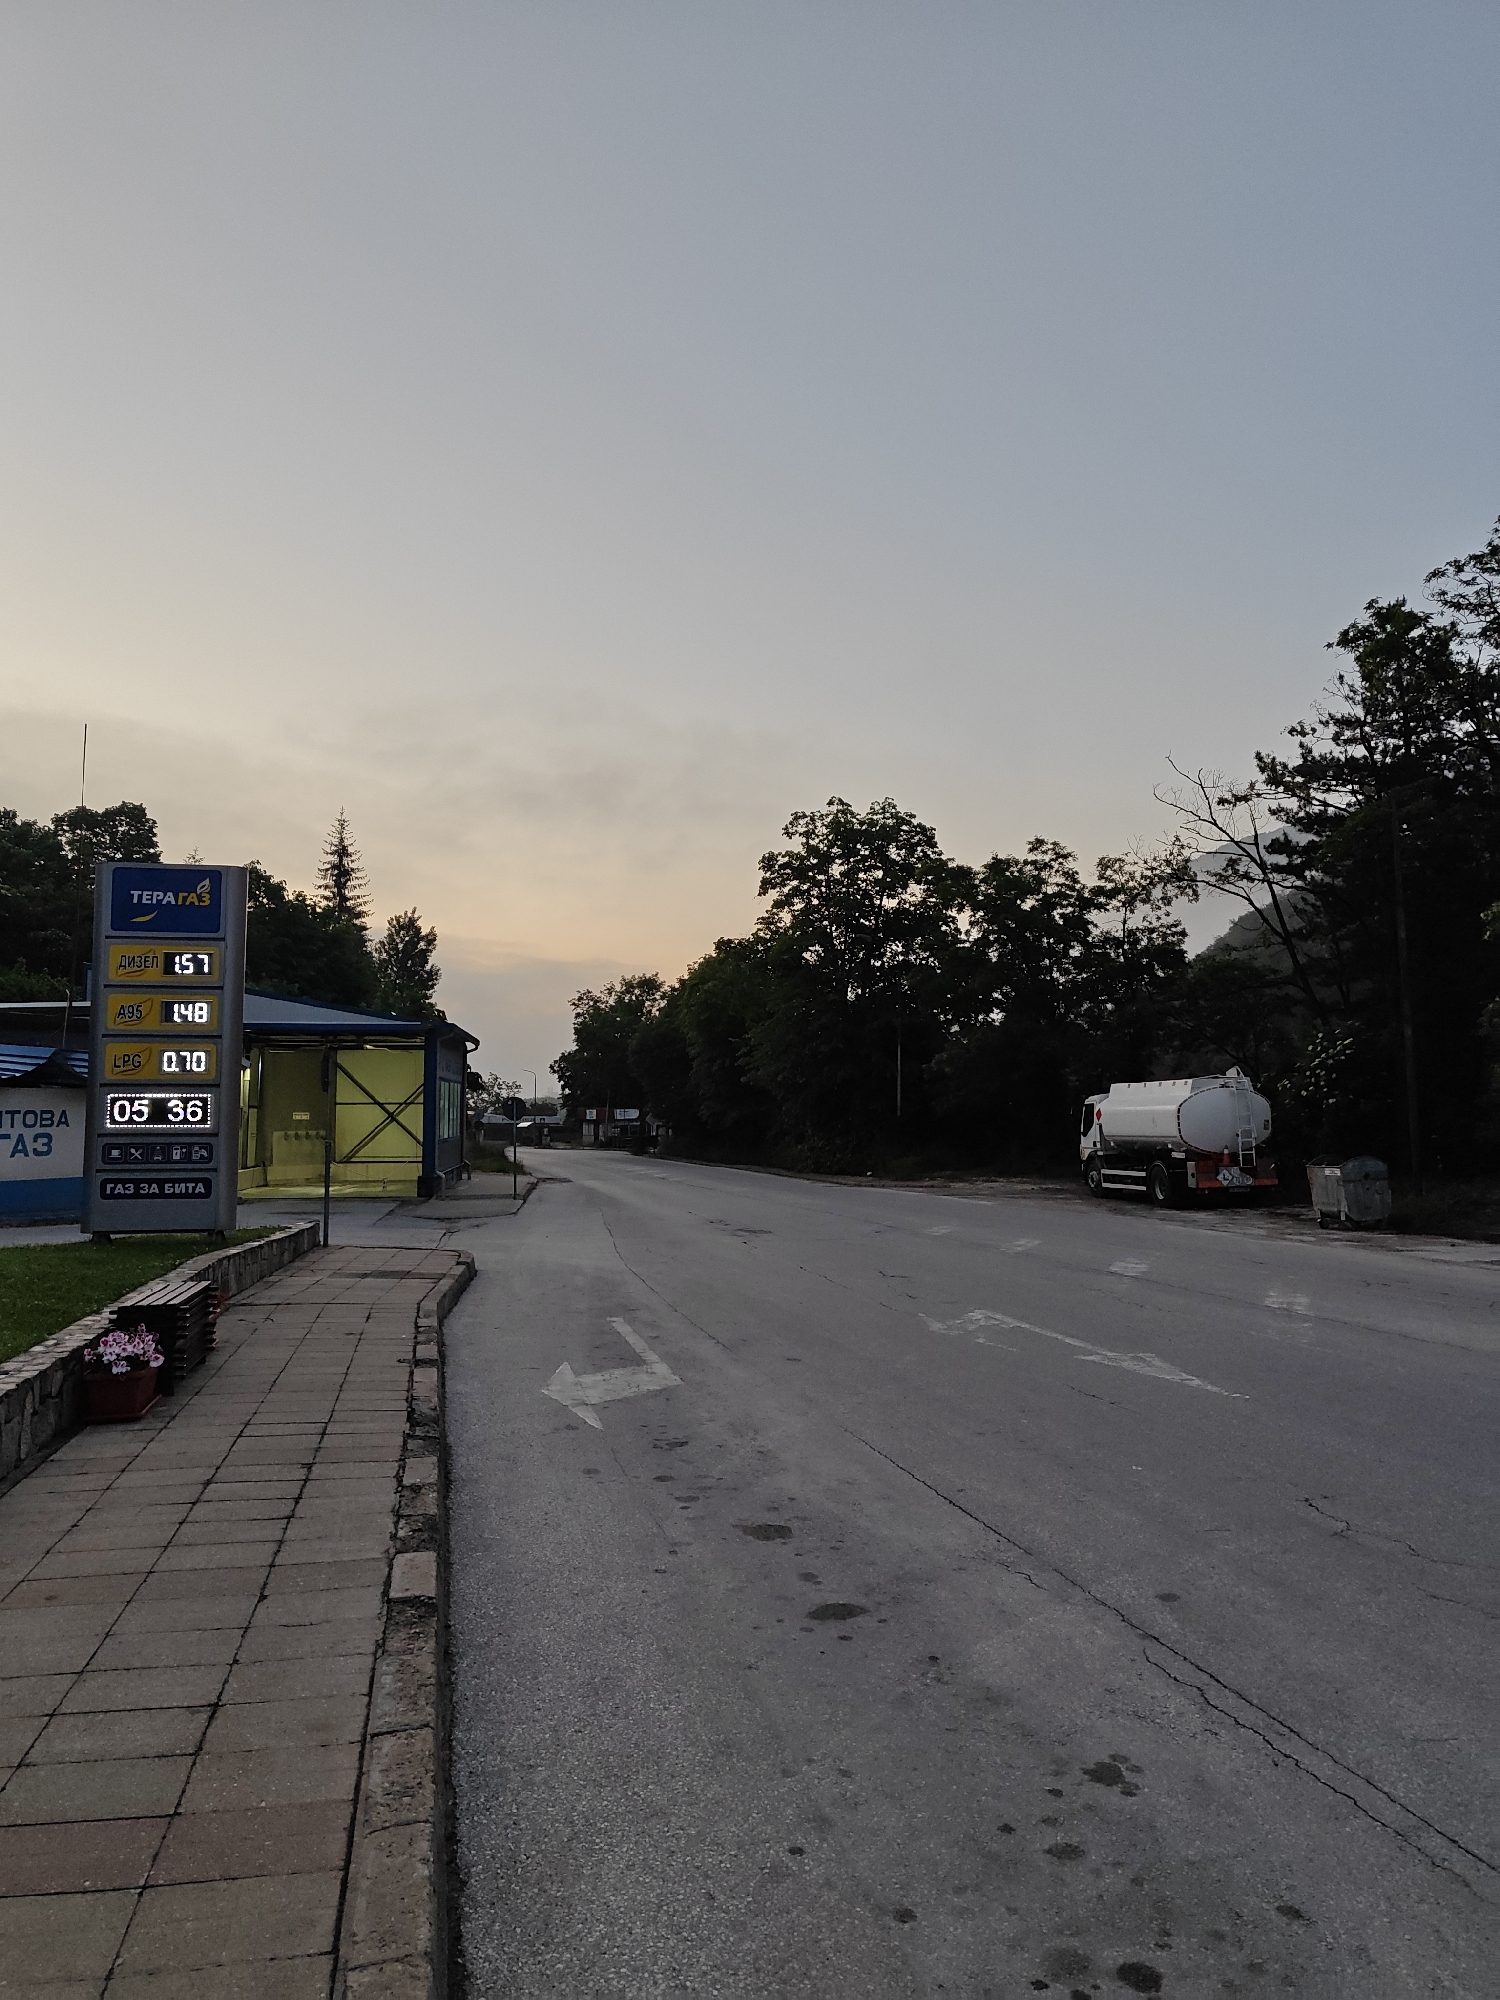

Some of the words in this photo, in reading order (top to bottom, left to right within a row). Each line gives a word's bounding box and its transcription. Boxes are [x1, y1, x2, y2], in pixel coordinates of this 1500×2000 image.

[119, 955, 159, 970] ДИЗЕЛ
[173, 1002, 208, 1023] 1.48
[113, 1053, 142, 1069] LPG
[163, 1051, 206, 1072] 0.70
[0, 1109, 70, 1129] ТОВА
[113, 1100, 149, 1123] 05
[167, 1100, 203, 1123] 36
[106, 1183, 135, 1195] ГАЗ
[139, 1183, 160, 1194] ЗА
[164, 1182, 206, 1194] БИТА
